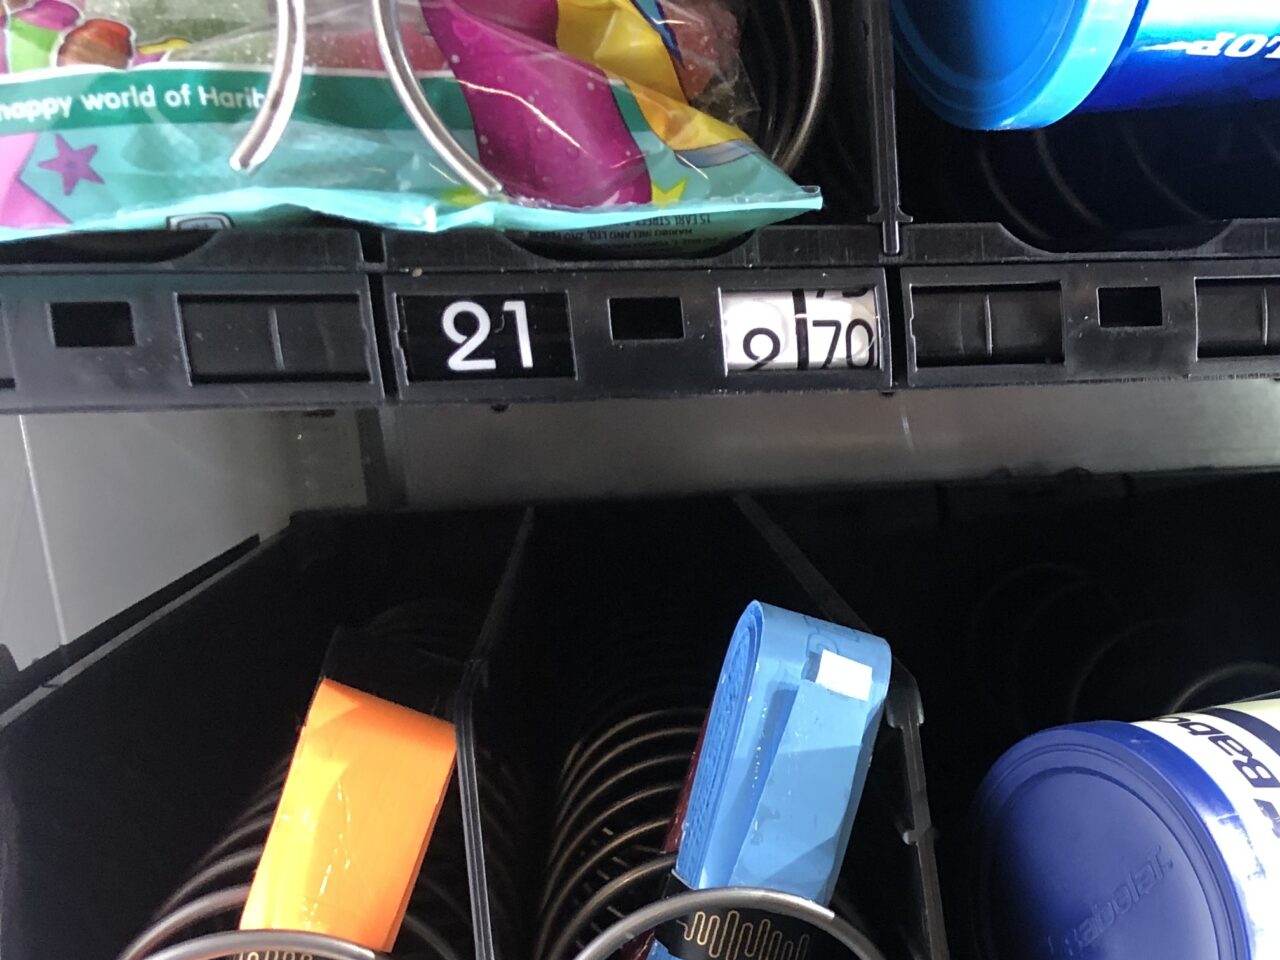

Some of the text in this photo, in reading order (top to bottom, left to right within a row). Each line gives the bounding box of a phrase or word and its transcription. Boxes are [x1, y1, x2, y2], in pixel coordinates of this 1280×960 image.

[81, 84, 157, 112] world
[165, 83, 192, 108] of
[200, 84, 268, 109] Harib
[441, 300, 534, 372] 21
